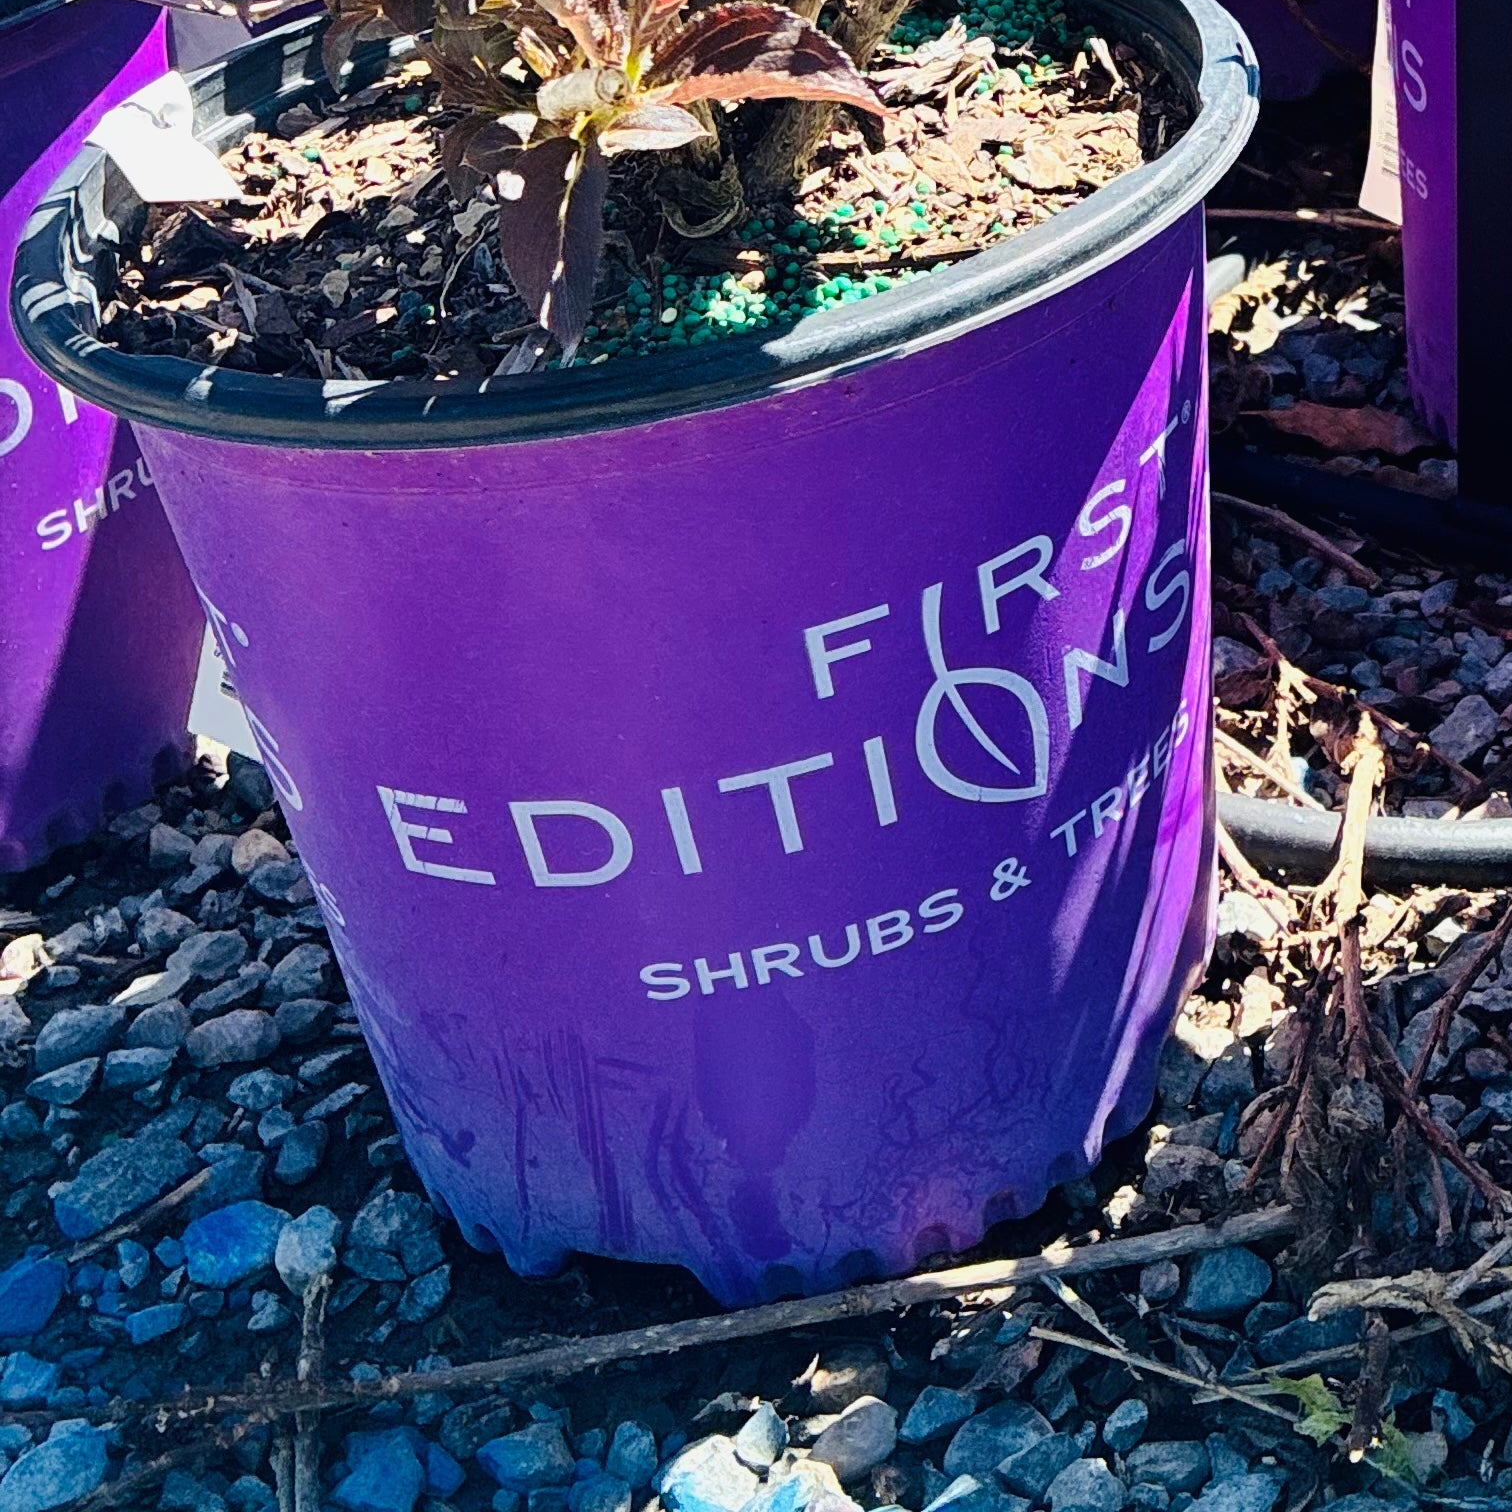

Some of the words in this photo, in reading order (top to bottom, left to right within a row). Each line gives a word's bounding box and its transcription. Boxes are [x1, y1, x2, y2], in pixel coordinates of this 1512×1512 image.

[376, 538, 1190, 888] EDITIONS
[639, 888, 965, 1002] SHRUBS
[989, 856, 1032, 901] &
[1049, 699, 1189, 858] TREES
